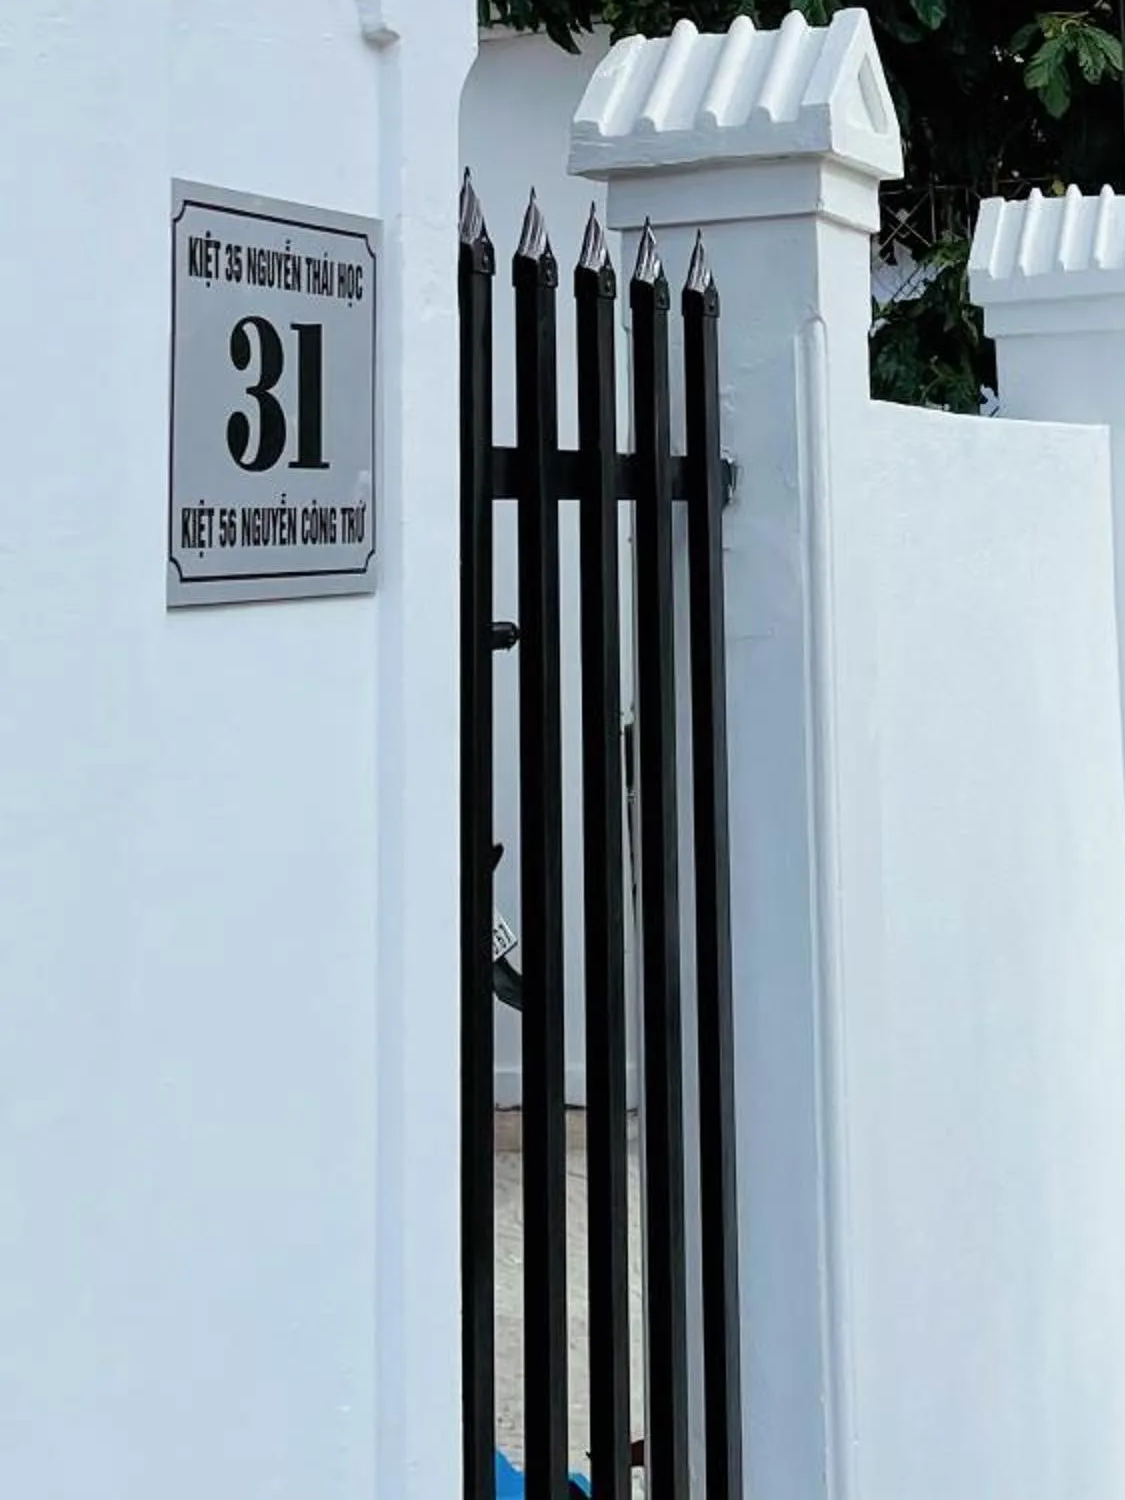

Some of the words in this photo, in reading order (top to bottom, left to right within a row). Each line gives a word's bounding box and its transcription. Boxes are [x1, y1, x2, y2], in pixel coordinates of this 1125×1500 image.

[188, 230, 221, 288] KIỆT
[225, 243, 243, 284] 35
[305, 251, 334, 297] THÁI
[337, 263, 363, 308] HỌC
[226, 315, 331, 473] 31
[181, 499, 215, 559] KIỆT
[219, 507, 237, 549] 56
[301, 499, 337, 545] CÔNG
